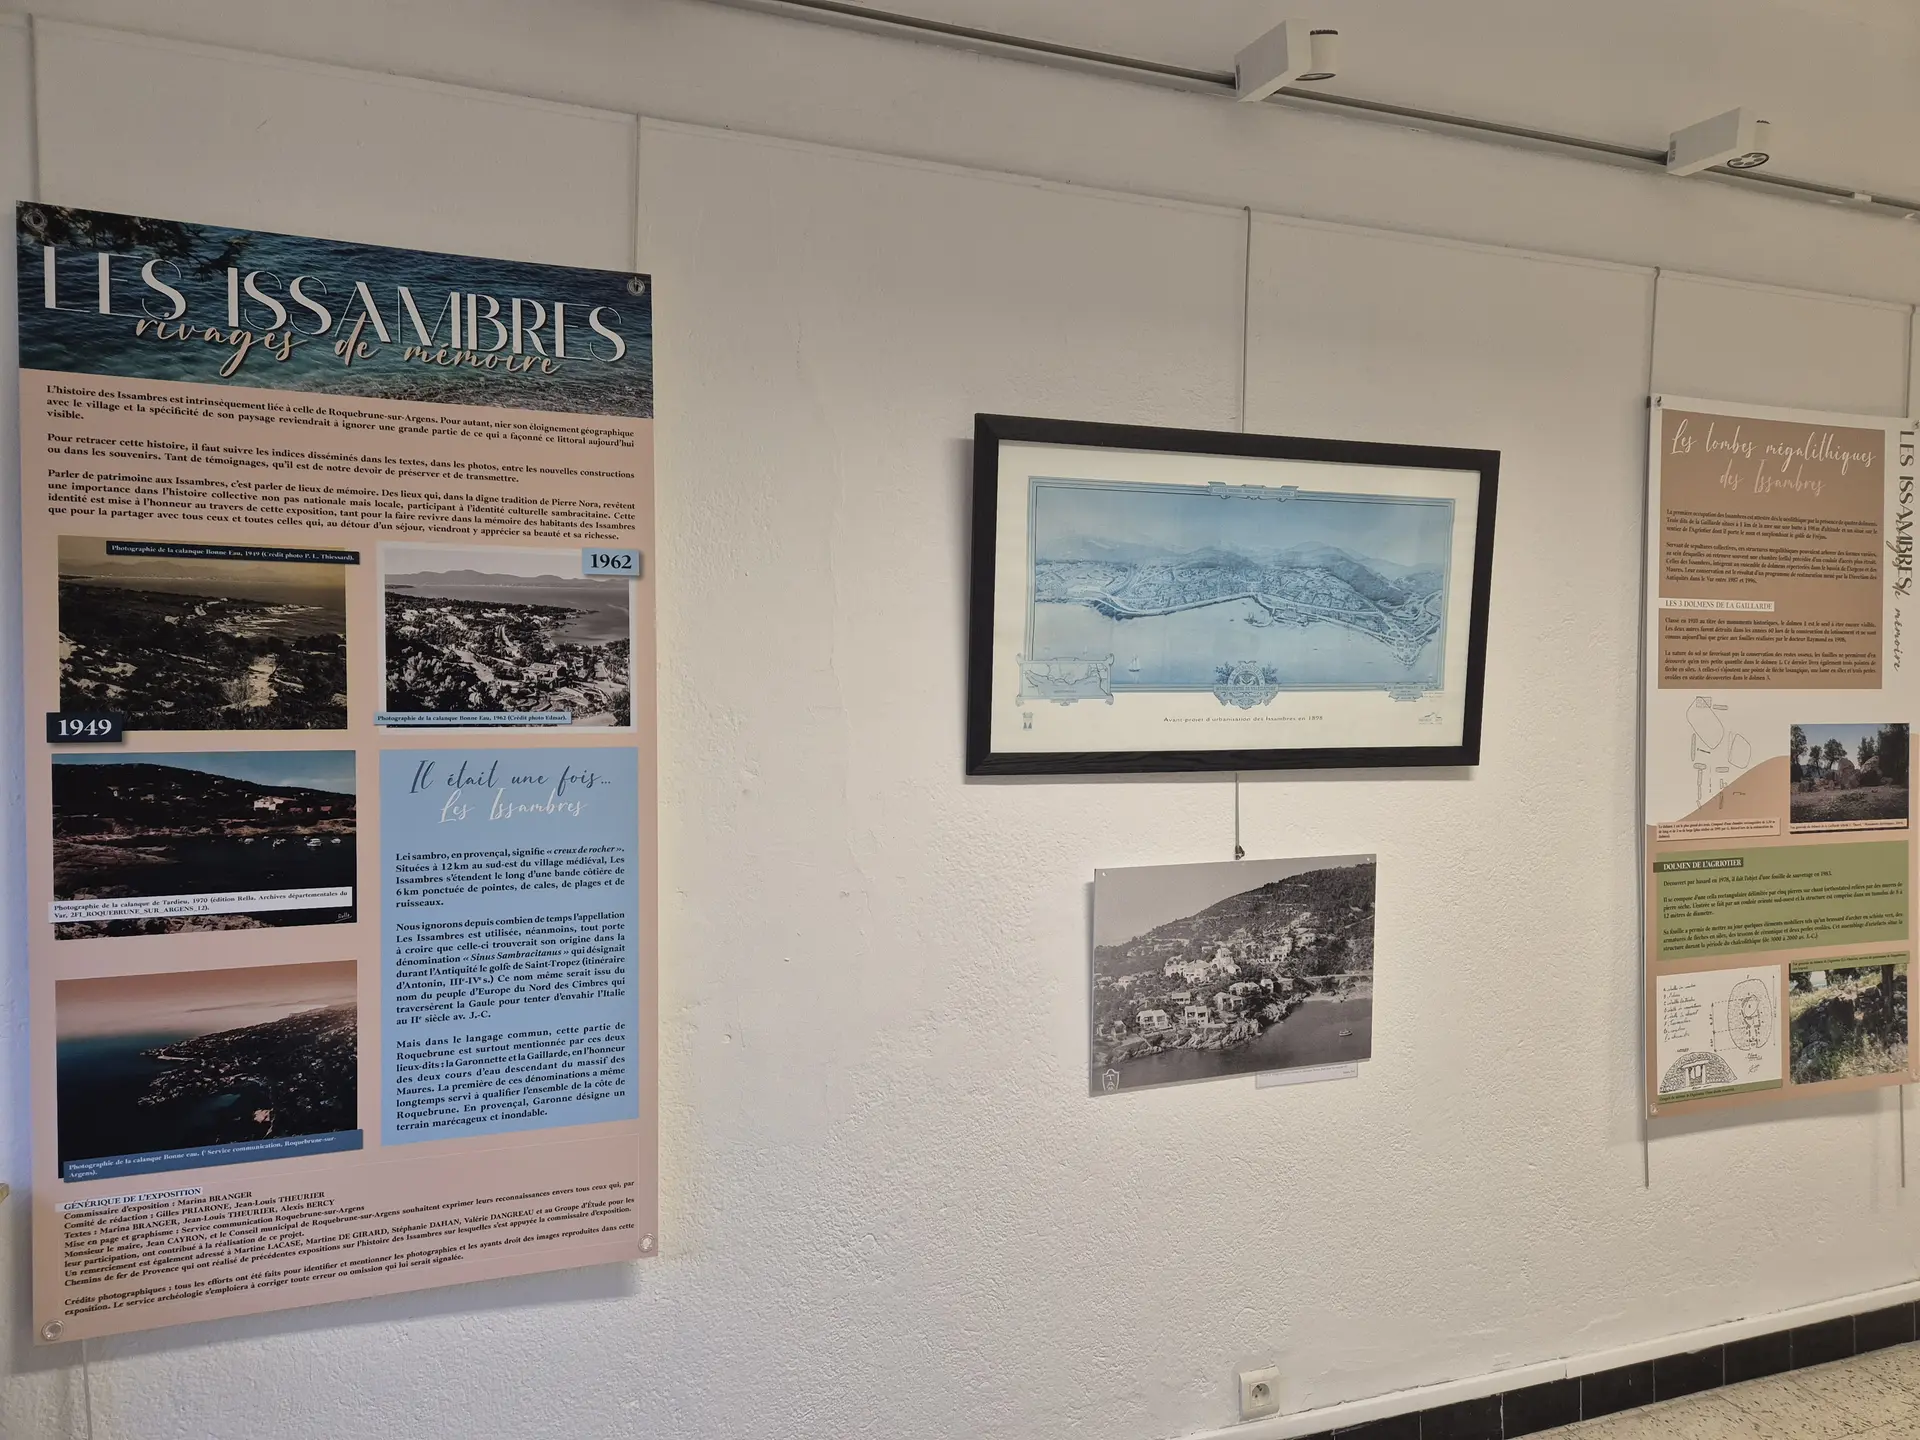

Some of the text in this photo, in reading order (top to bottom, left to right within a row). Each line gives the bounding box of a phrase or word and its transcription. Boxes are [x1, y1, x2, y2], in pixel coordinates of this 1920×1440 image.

[44, 245, 627, 363] LES ISSAMBRES
[135, 311, 562, 378] rivages de mémoire
[46, 386, 97, 398] L'histoire
[96, 389, 115, 399] des
[117, 391, 167, 403] Issambres
[185, 396, 265, 410] intrinsèquement
[267, 402, 284, 411] liée
[292, 404, 314, 414] celle
[315, 405, 326, 414] de
[328, 407, 438, 423] Roquebrune-sur-Argens.
[440, 415, 461, 424] Pour
[462, 419, 492, 428] autant,
[494, 419, 511, 428] nier
[529, 422, 579, 433] éloignement
[580, 426, 634, 438] géographique
[1898, 430, 1914, 590] LES ISSAMBRES
[591, 553, 632, 570] 1962
[1683, 600, 1714, 608] DOLMENS
[57, 719, 112, 736] 1949
[410, 759, 436, 794] Il
[446, 760, 500, 789] était
[511, 773, 550, 785] une
[437, 787, 590, 824] Les Issambres
[395, 864, 429, 872] Situées
[441, 863, 452, 871] 12
[485, 861, 517, 869] sud-est
[519, 860, 532, 868] du
[533, 859, 563, 868] village
[566, 856, 607, 866] médiéval,
[396, 852, 410, 860] Lei
[411, 852, 449, 860] sambro,
[463, 849, 510, 860] provençal,
[511, 848, 545, 858] signifie
[576, 846, 588, 854] de
[588, 845, 615, 853] rocher
[54, 902, 99, 911] Photographie
[120, 900, 150, 908] calanque
[210, 896, 235, 904] (édition
[287, 891, 338, 900] départementales
[63, 1198, 120, 1210] GÉNÉRIQUE
[137, 1189, 200, 1202] L'EXPOSITION
[63, 1207, 118, 1219] Commissaire
[121, 1202, 169, 1213] d'exposition
[177, 1198, 206, 1206] Marina
[209, 1192, 252, 1203] BRANGER
[63, 1219, 94, 1228] Comité
[109, 1214, 148, 1223] rédaction
[155, 1210, 179, 1218] Gilles
[181, 1204, 231, 1215] PRIARONE,
[233, 1198, 276, 1209] Jean-Louis
[277, 1193, 325, 1204] THEURIER
